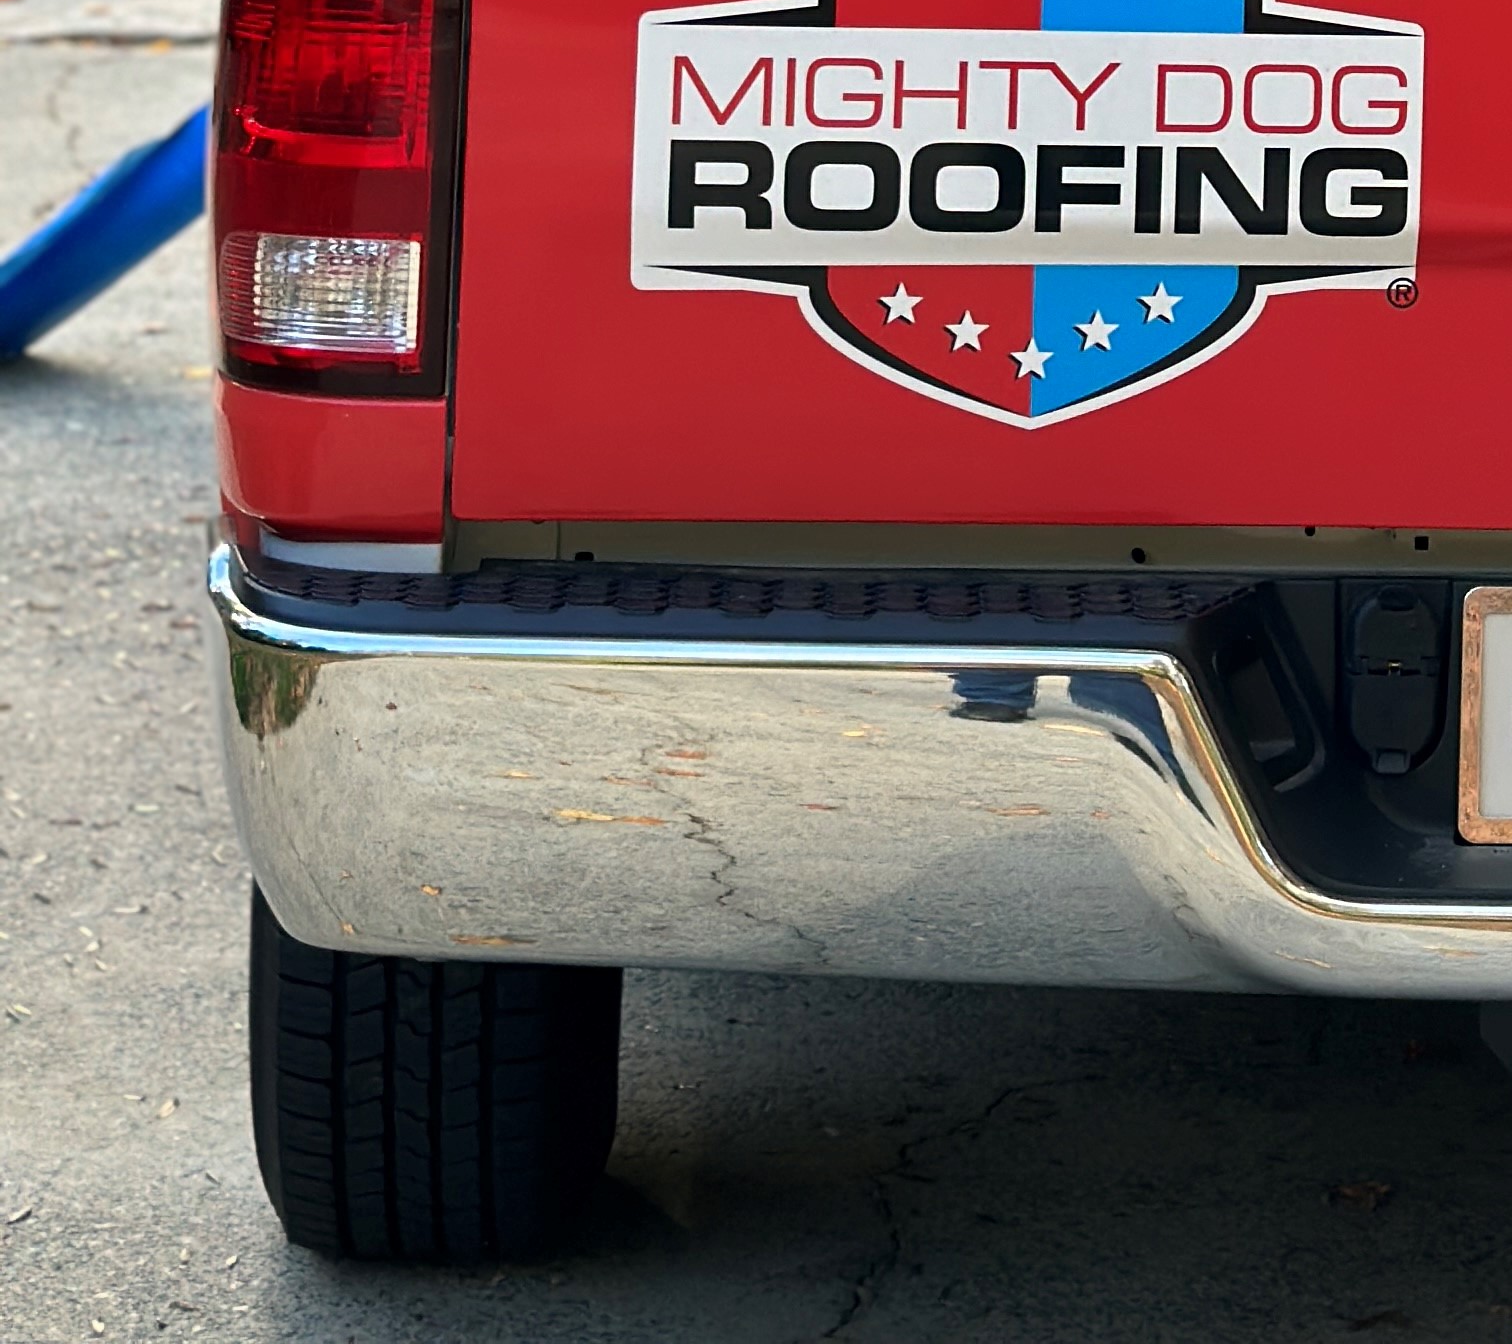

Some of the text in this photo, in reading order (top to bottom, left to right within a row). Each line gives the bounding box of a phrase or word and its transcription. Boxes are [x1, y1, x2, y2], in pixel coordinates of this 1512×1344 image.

[670, 55, 1409, 136] MIGHTY DOG
[666, 138, 1410, 238] ROOFING
